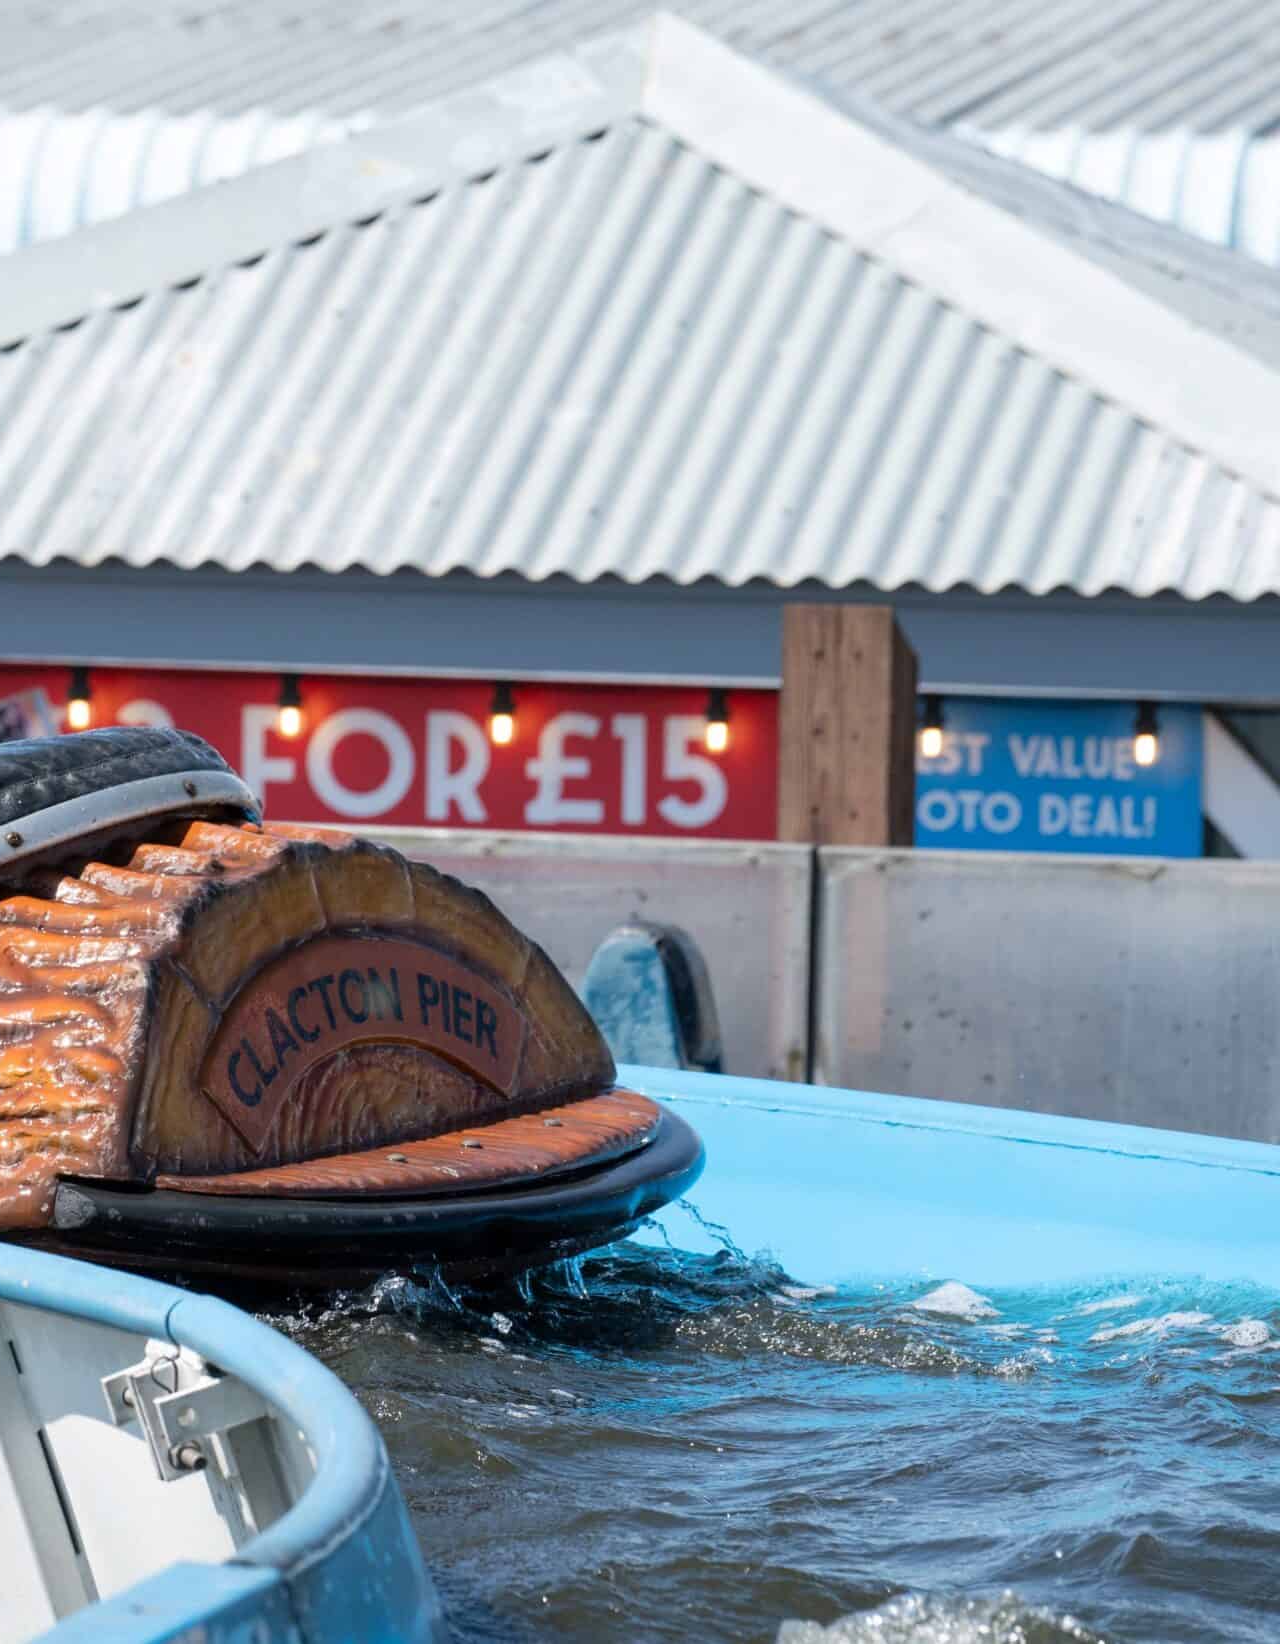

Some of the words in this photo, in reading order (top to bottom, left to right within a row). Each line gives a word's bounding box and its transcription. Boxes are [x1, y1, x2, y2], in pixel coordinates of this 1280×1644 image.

[241, 704, 488, 822] FOR
[524, 710, 728, 828] £15
[1007, 735, 1134, 781] VALUE
[1038, 794, 1157, 838] DEAL!
[227, 966, 404, 1107] CLACTON
[417, 973, 498, 1059] PIER
